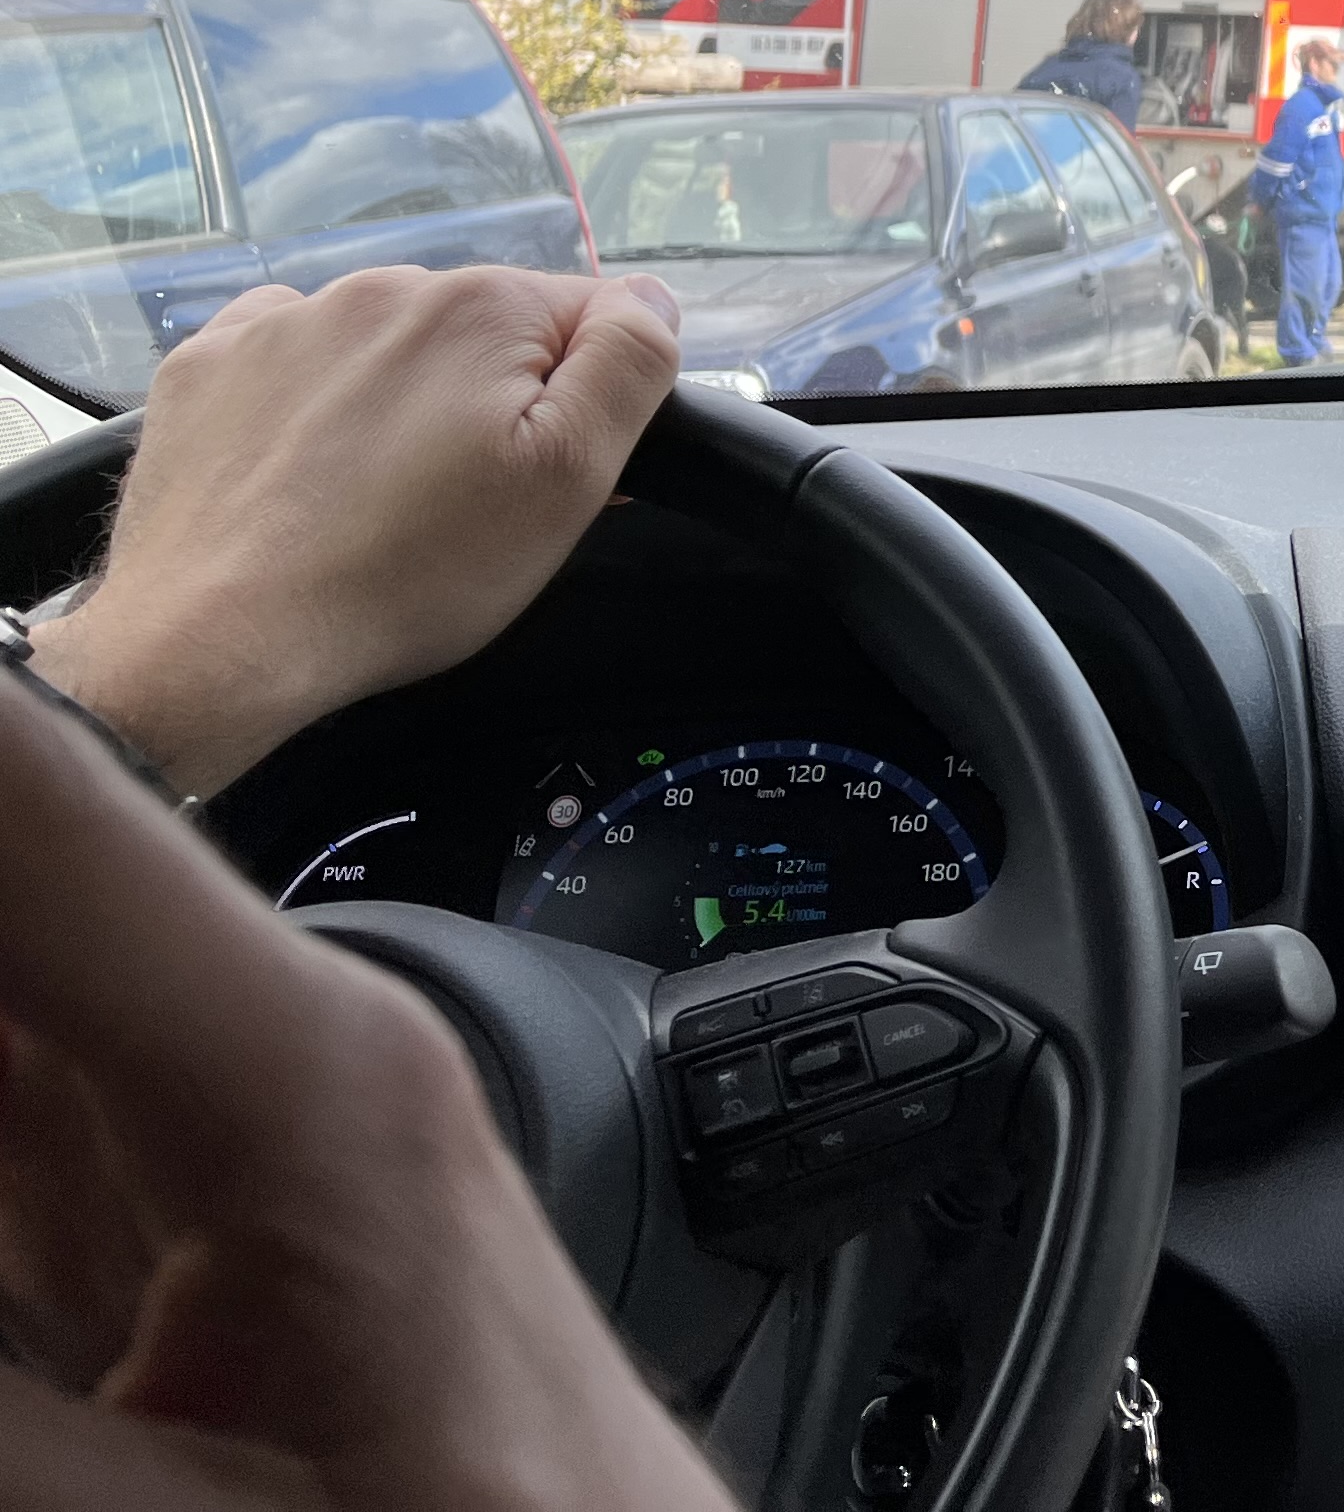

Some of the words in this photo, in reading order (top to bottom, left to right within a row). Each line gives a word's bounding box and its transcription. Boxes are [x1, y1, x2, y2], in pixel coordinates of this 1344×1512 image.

[720, 768, 759, 787] 100
[787, 764, 826, 783] 120
[663, 787, 694, 807] 80
[756, 787, 786, 800] km/h
[843, 781, 882, 800] 140
[555, 804, 575, 820] 30
[889, 814, 928, 833] 160
[604, 824, 634, 844] 60
[323, 865, 366, 883] PWR
[776, 859, 806, 874] 127
[806, 860, 827, 872] km
[921, 863, 960, 882] 180
[556, 875, 587, 895] 40
[1186, 871, 1201, 889] R
[742, 899, 786, 924] 5.4
[883, 1022, 927, 1046] CANCEL
